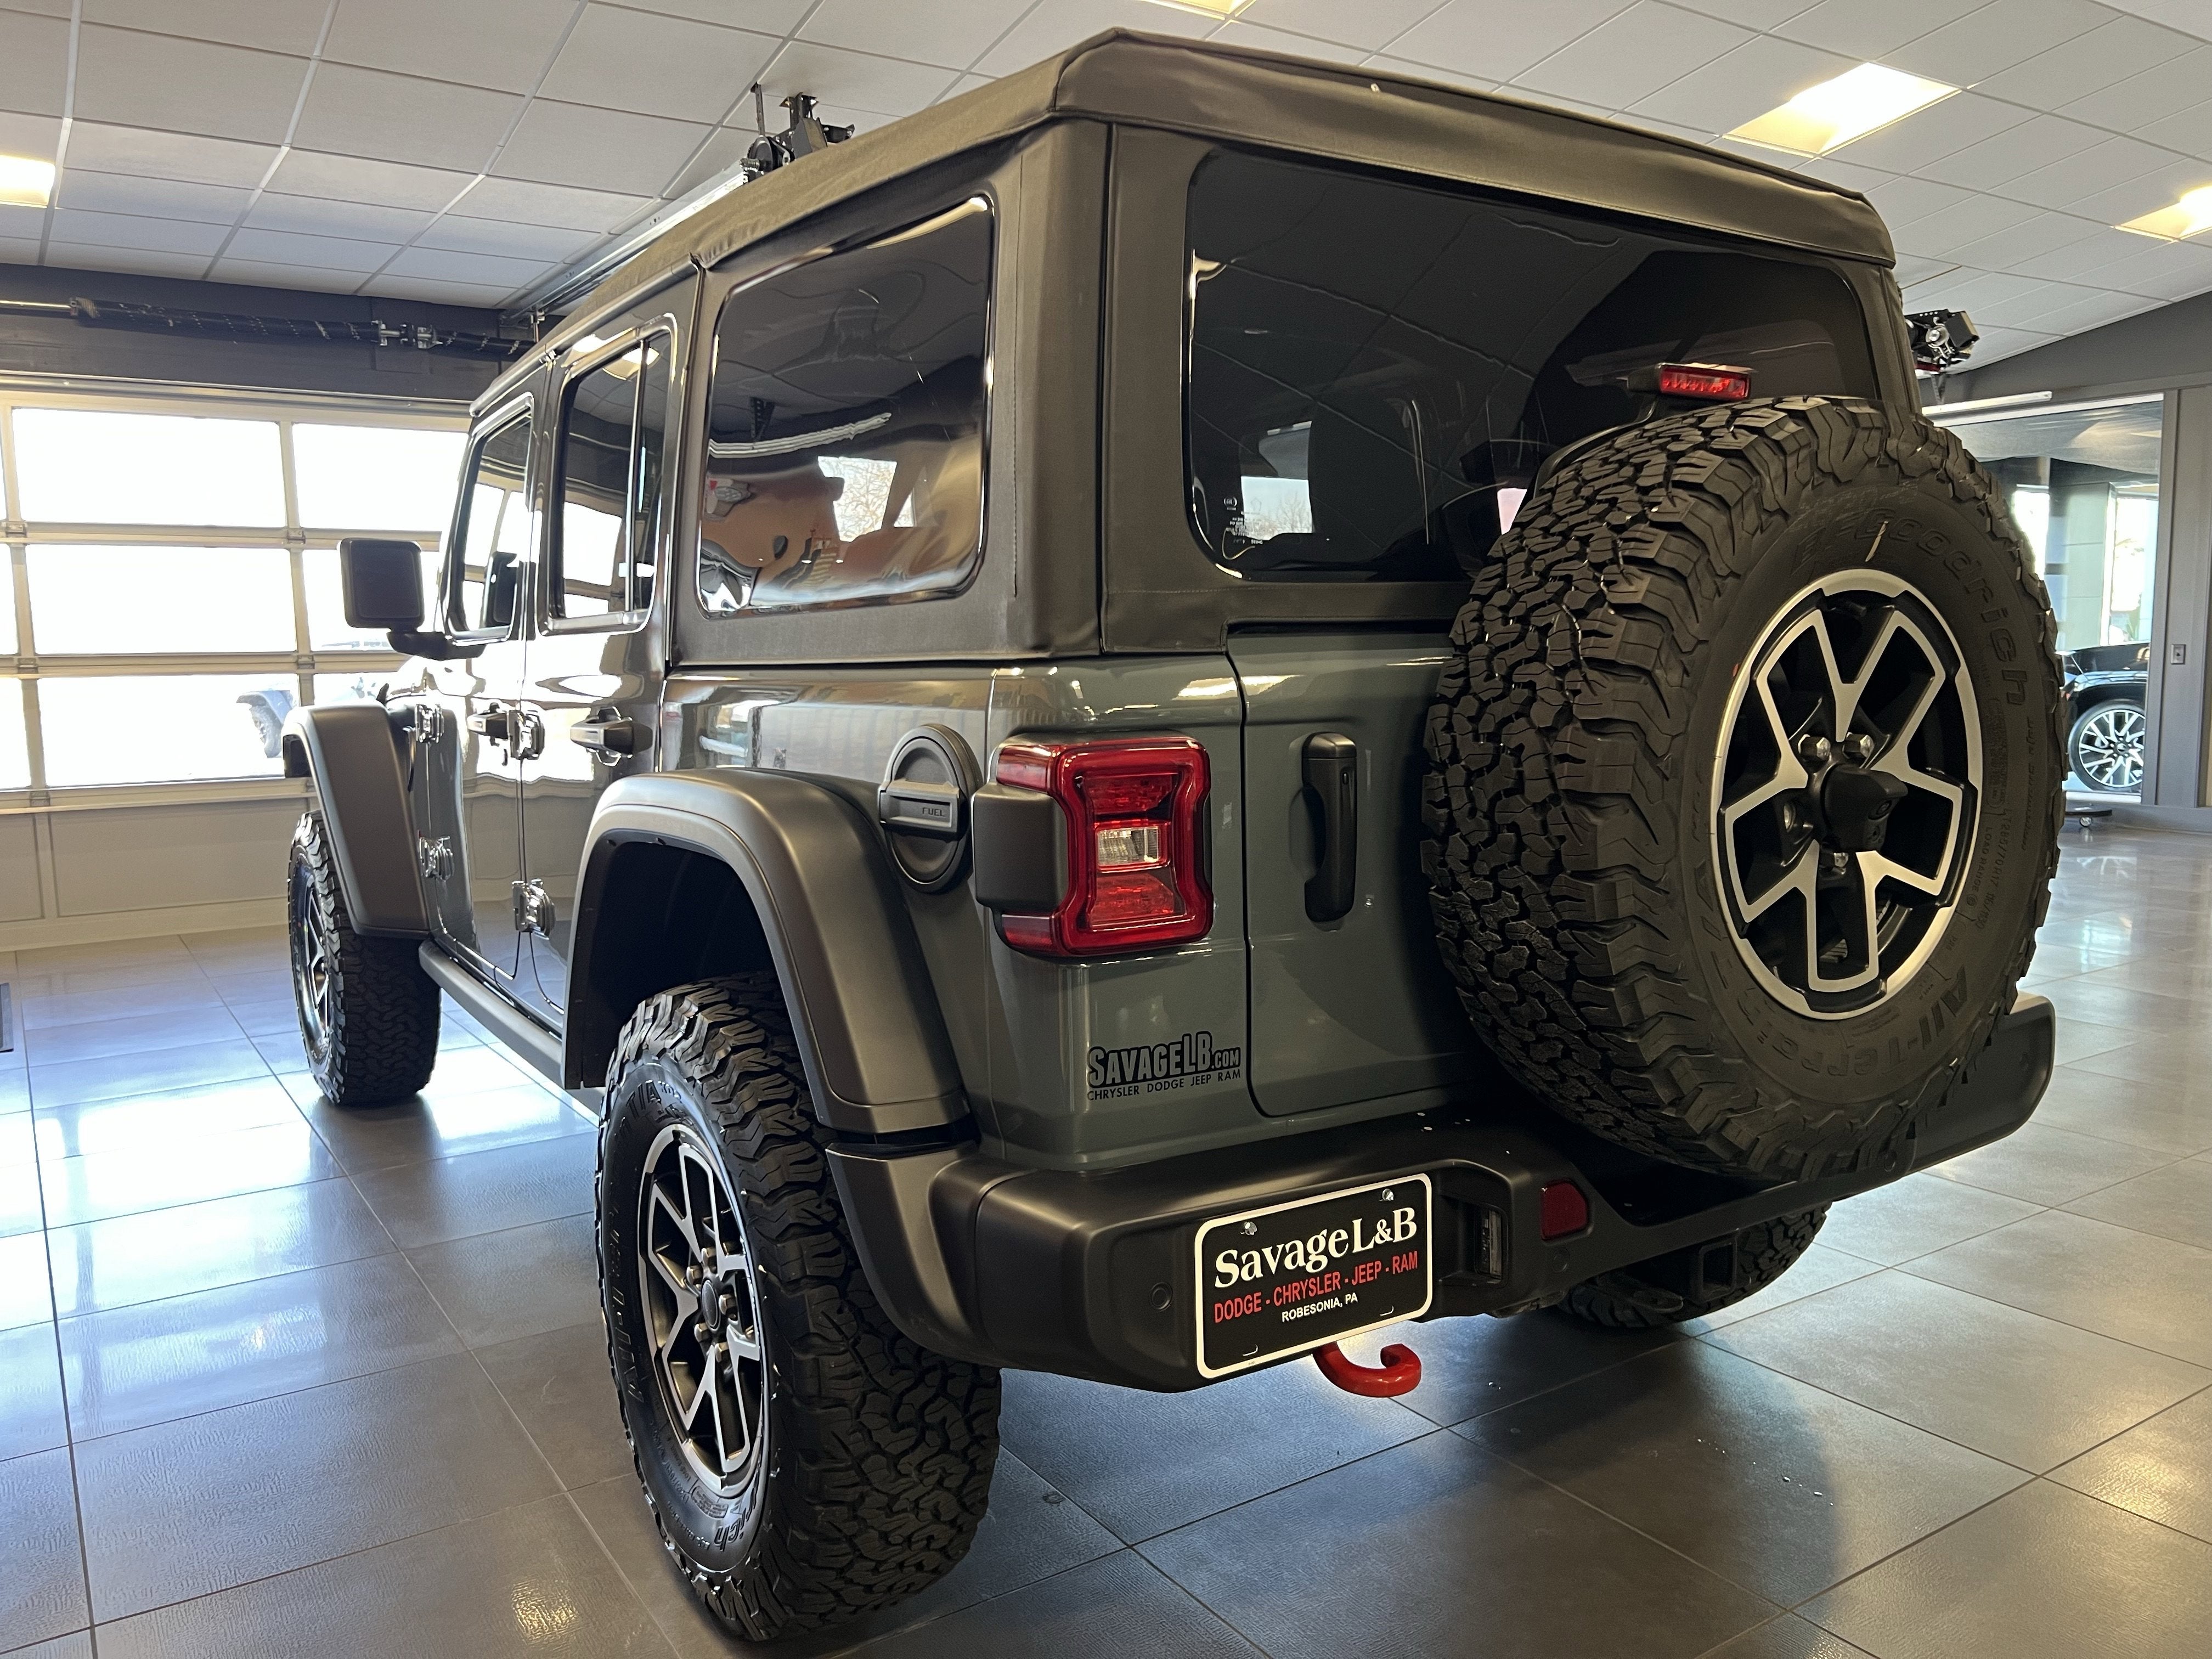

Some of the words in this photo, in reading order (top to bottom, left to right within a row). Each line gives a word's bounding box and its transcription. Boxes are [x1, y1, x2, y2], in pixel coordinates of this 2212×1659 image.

[922, 806, 946, 817] FUEL
[1087, 1085, 1139, 1101] CHRYSLER
[1147, 1078, 1185, 1093] DODGE
[1190, 1074, 1212, 1087] JEEP
[1217, 1068, 1242, 1082] RAM
[1214, 1291, 1262, 1324] DODGE
[1273, 1271, 1341, 1308] CHRYSLER
[1352, 1260, 1383, 1286] JEEP
[1392, 1250, 1418, 1275] RAM
[1282, 1296, 1343, 1323] ROBESONIA,
[1345, 1291, 1358, 1305] PA
